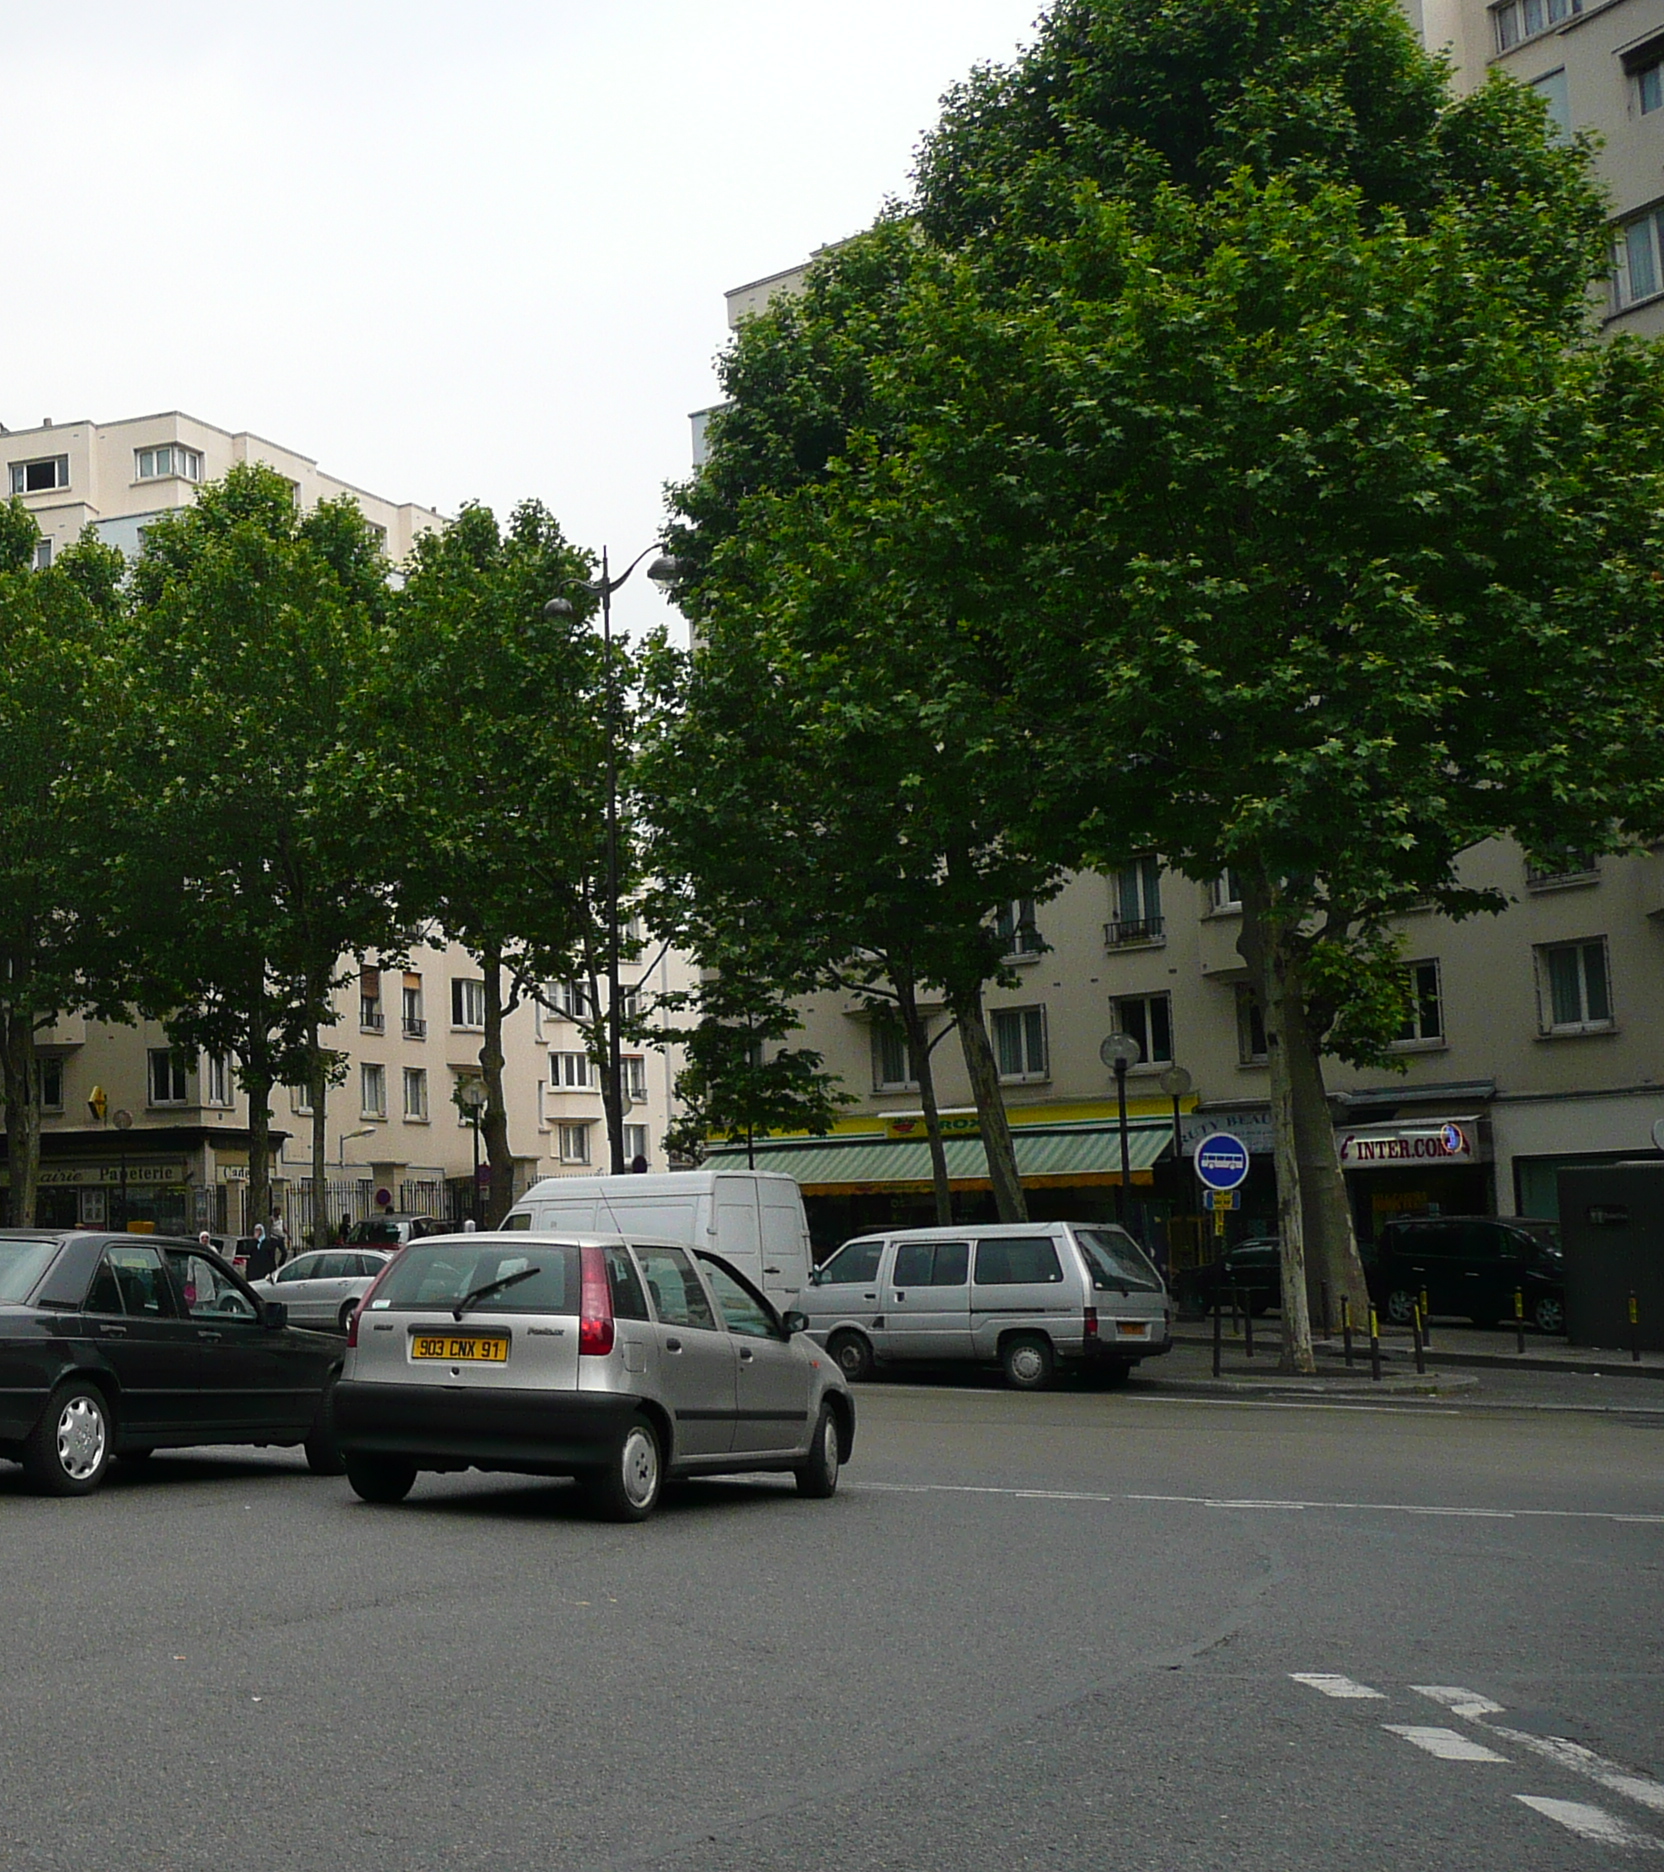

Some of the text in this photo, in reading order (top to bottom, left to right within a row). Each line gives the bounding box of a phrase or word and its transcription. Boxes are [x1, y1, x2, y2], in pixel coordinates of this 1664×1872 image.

[40, 1168, 82, 1182] airie
[419, 1340, 499, 1358] 903 CNX 91
